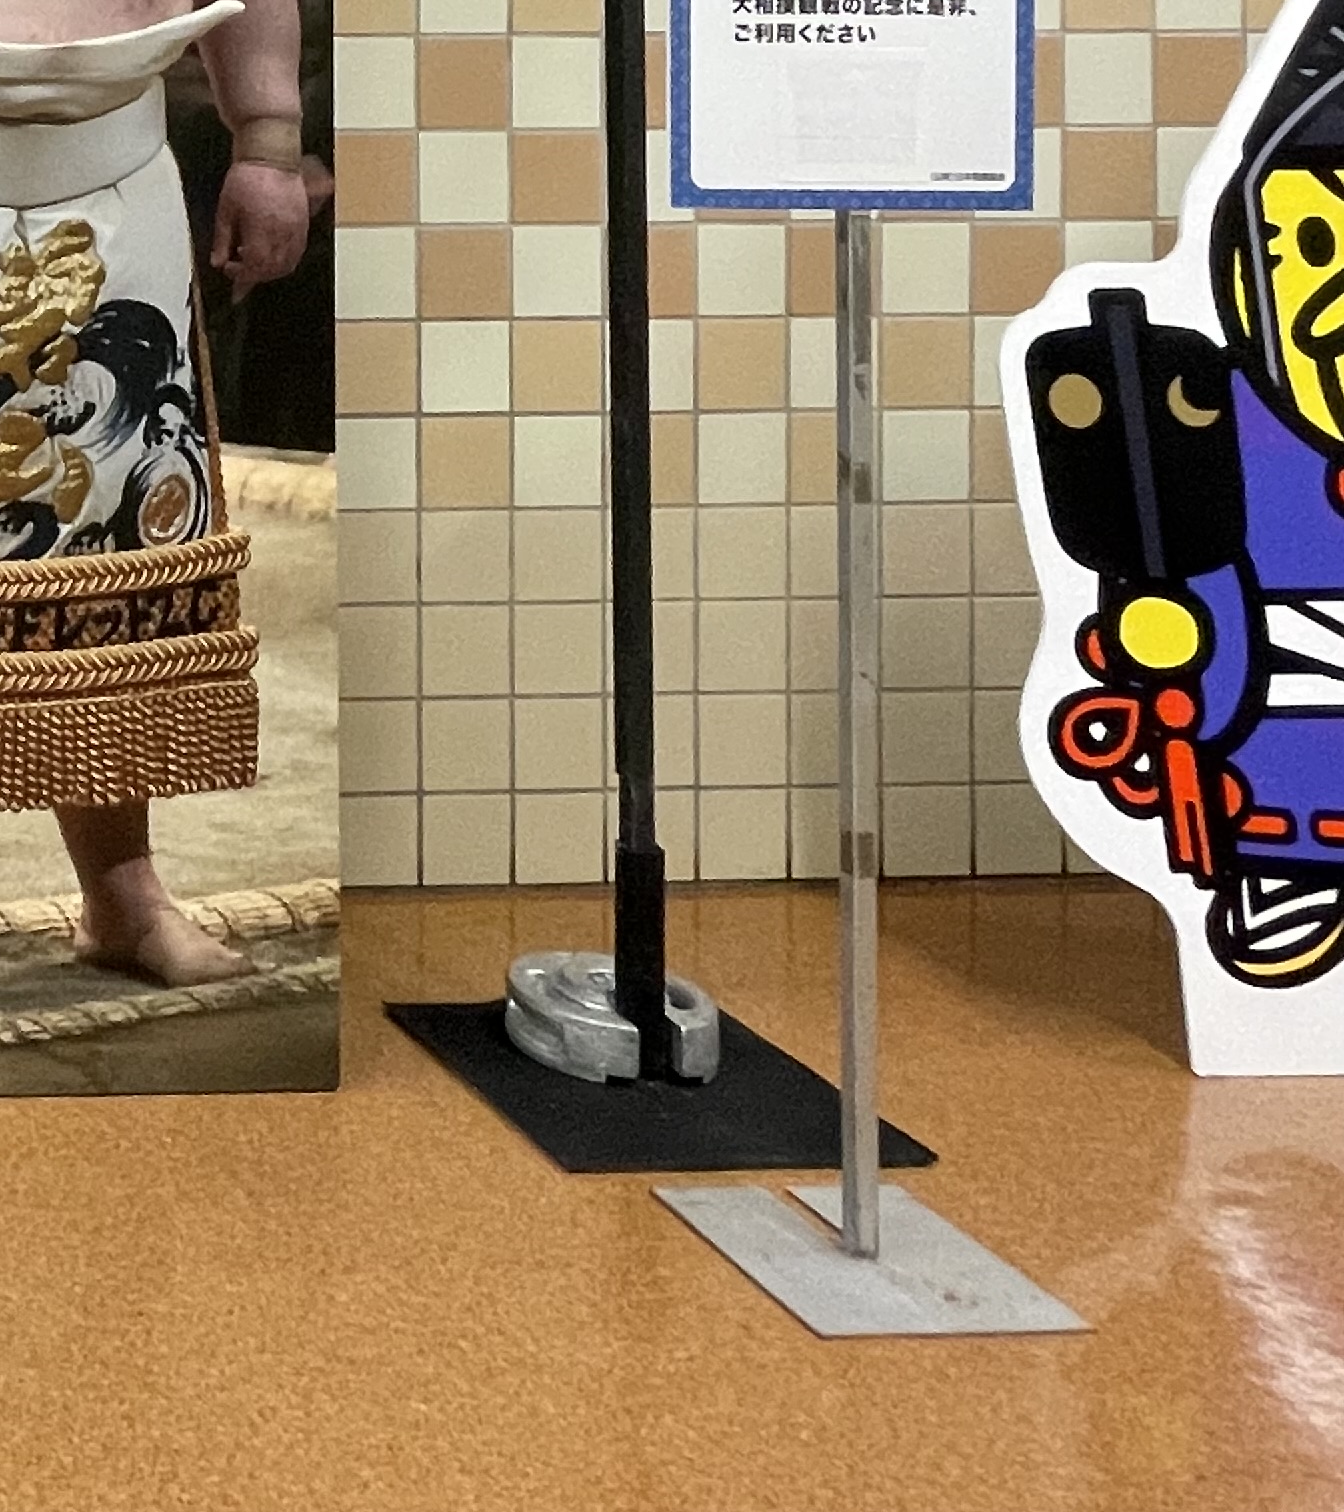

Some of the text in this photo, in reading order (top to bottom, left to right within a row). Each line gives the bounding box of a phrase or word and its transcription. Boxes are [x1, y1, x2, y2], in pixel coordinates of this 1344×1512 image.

[734, 23, 877, 44] ご利用ください
